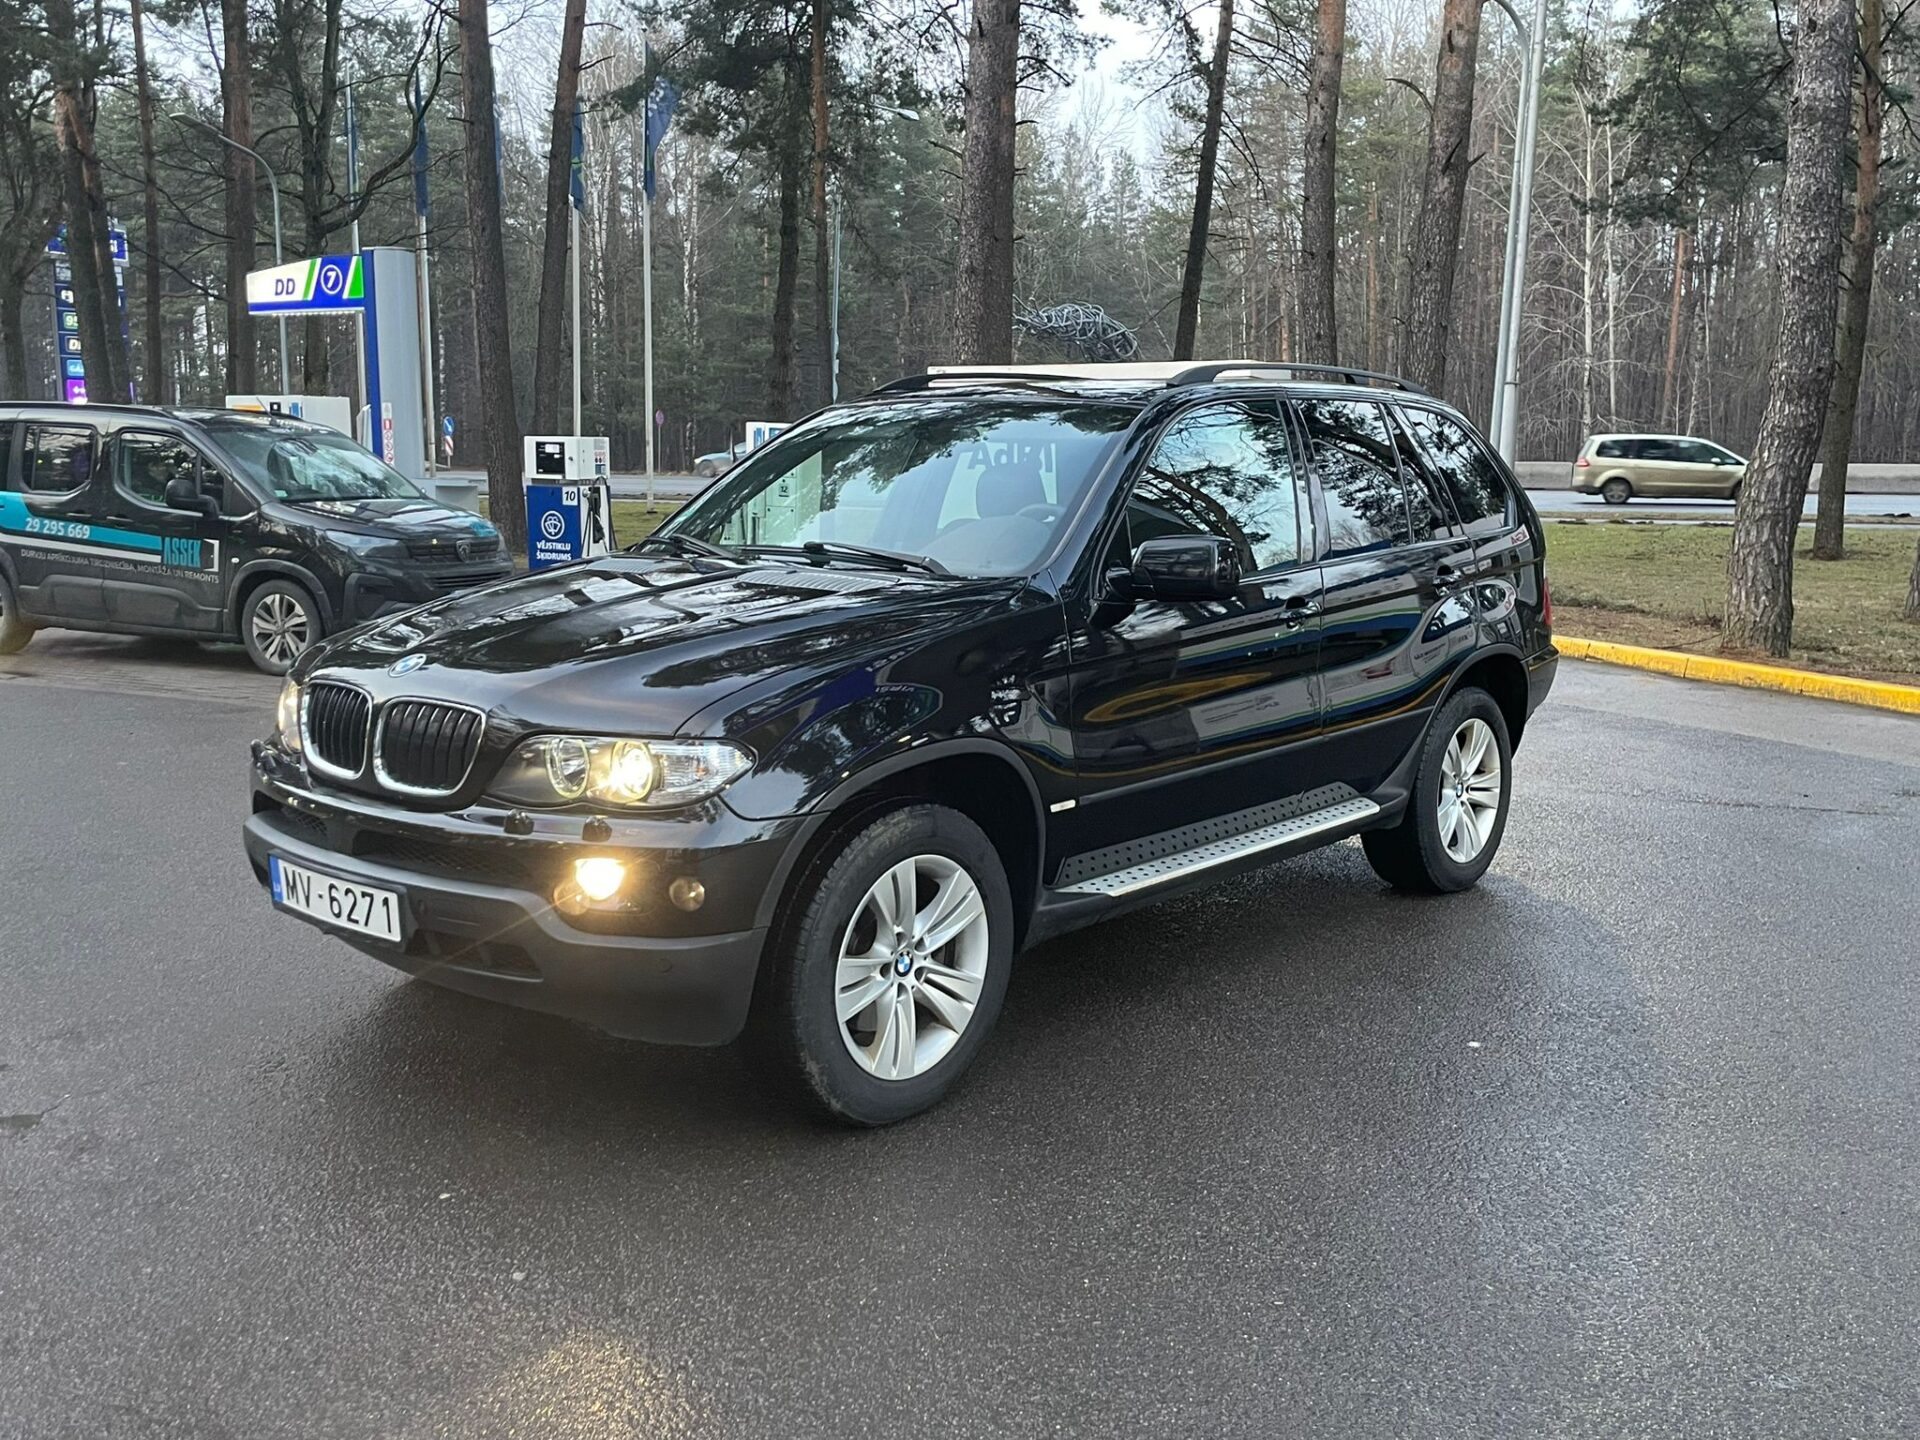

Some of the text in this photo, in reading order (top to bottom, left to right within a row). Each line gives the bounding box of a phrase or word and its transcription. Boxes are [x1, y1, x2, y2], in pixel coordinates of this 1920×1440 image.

[275, 278, 296, 296] DD
[326, 271, 337, 288] 7
[564, 490, 576, 501] 10
[25, 517, 91, 539] 29 295 669
[184, 570, 219, 584] REMONTS
[284, 866, 392, 933] MV-6271
